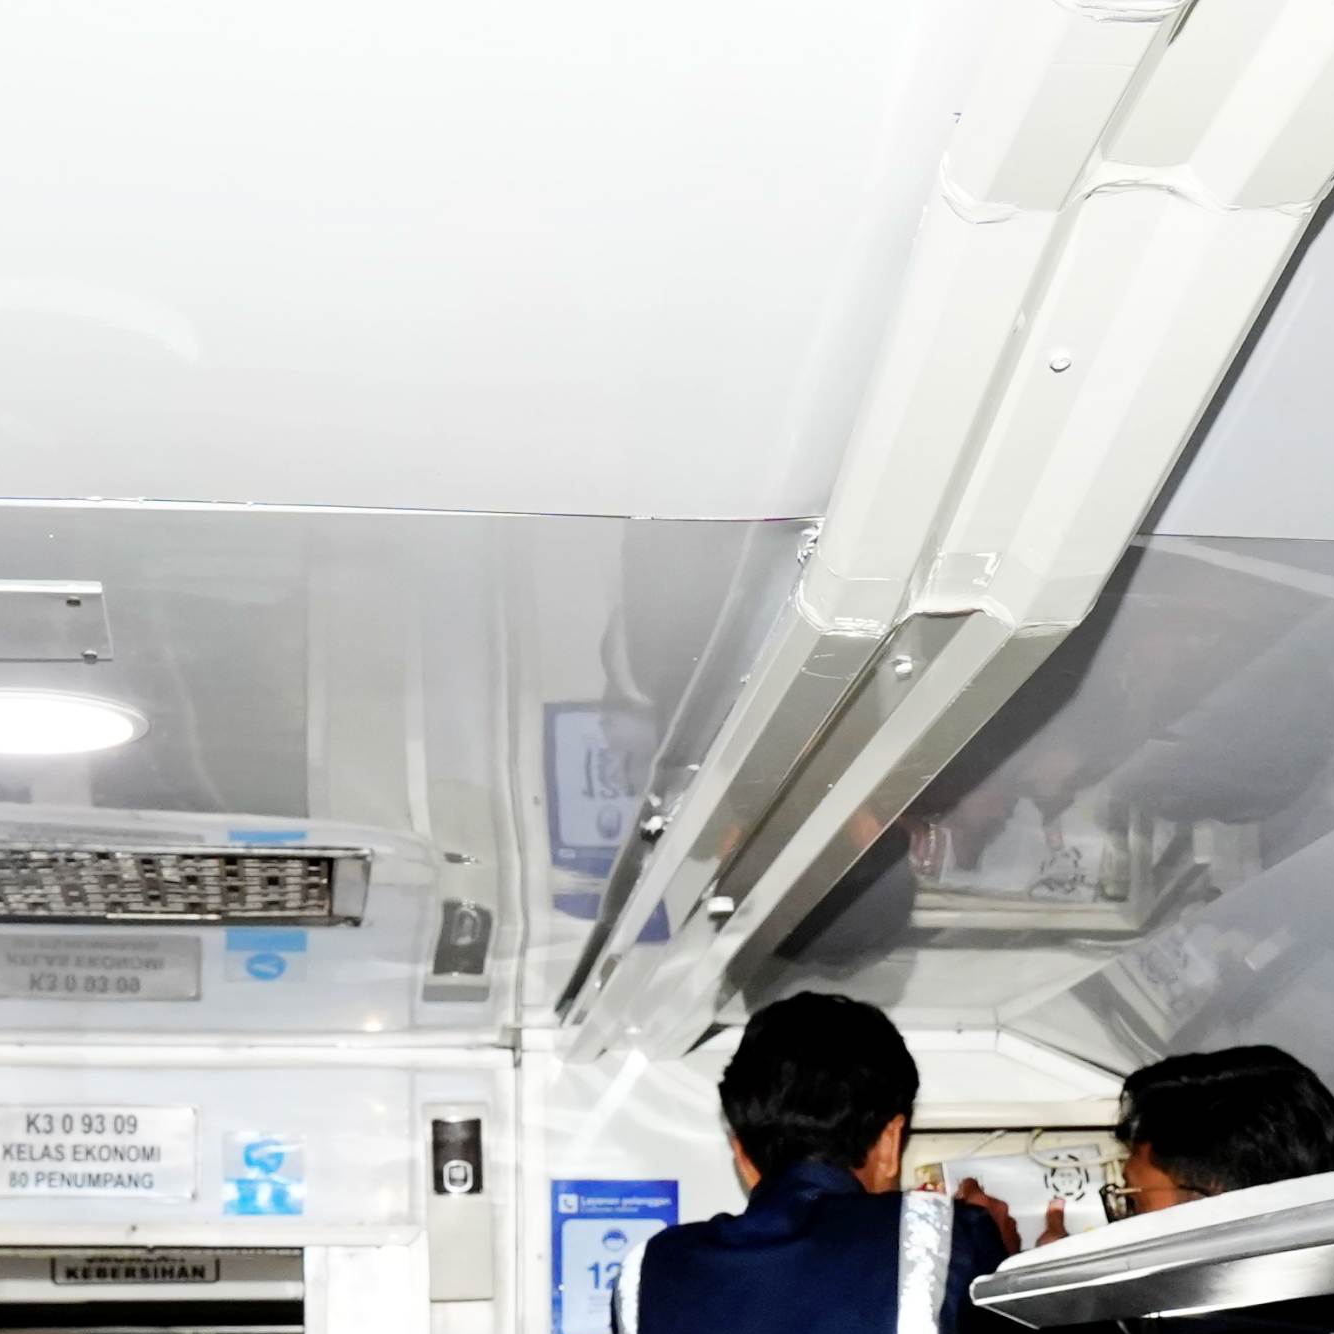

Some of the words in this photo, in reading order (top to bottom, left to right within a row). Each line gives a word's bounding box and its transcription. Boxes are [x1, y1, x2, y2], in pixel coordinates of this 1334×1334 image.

[26, 1113, 54, 1134] K3
[61, 1114, 74, 1134] 0
[80, 1114, 106, 1134] 93
[113, 1115, 138, 1134] 09
[2, 1143, 65, 1161] KELAS
[71, 1144, 161, 1162] EKONOMI
[35, 1171, 154, 1189] PENUMPANG
[65, 1264, 205, 1279] KEBERSIHAN
[587, 1261, 623, 1290] 12
